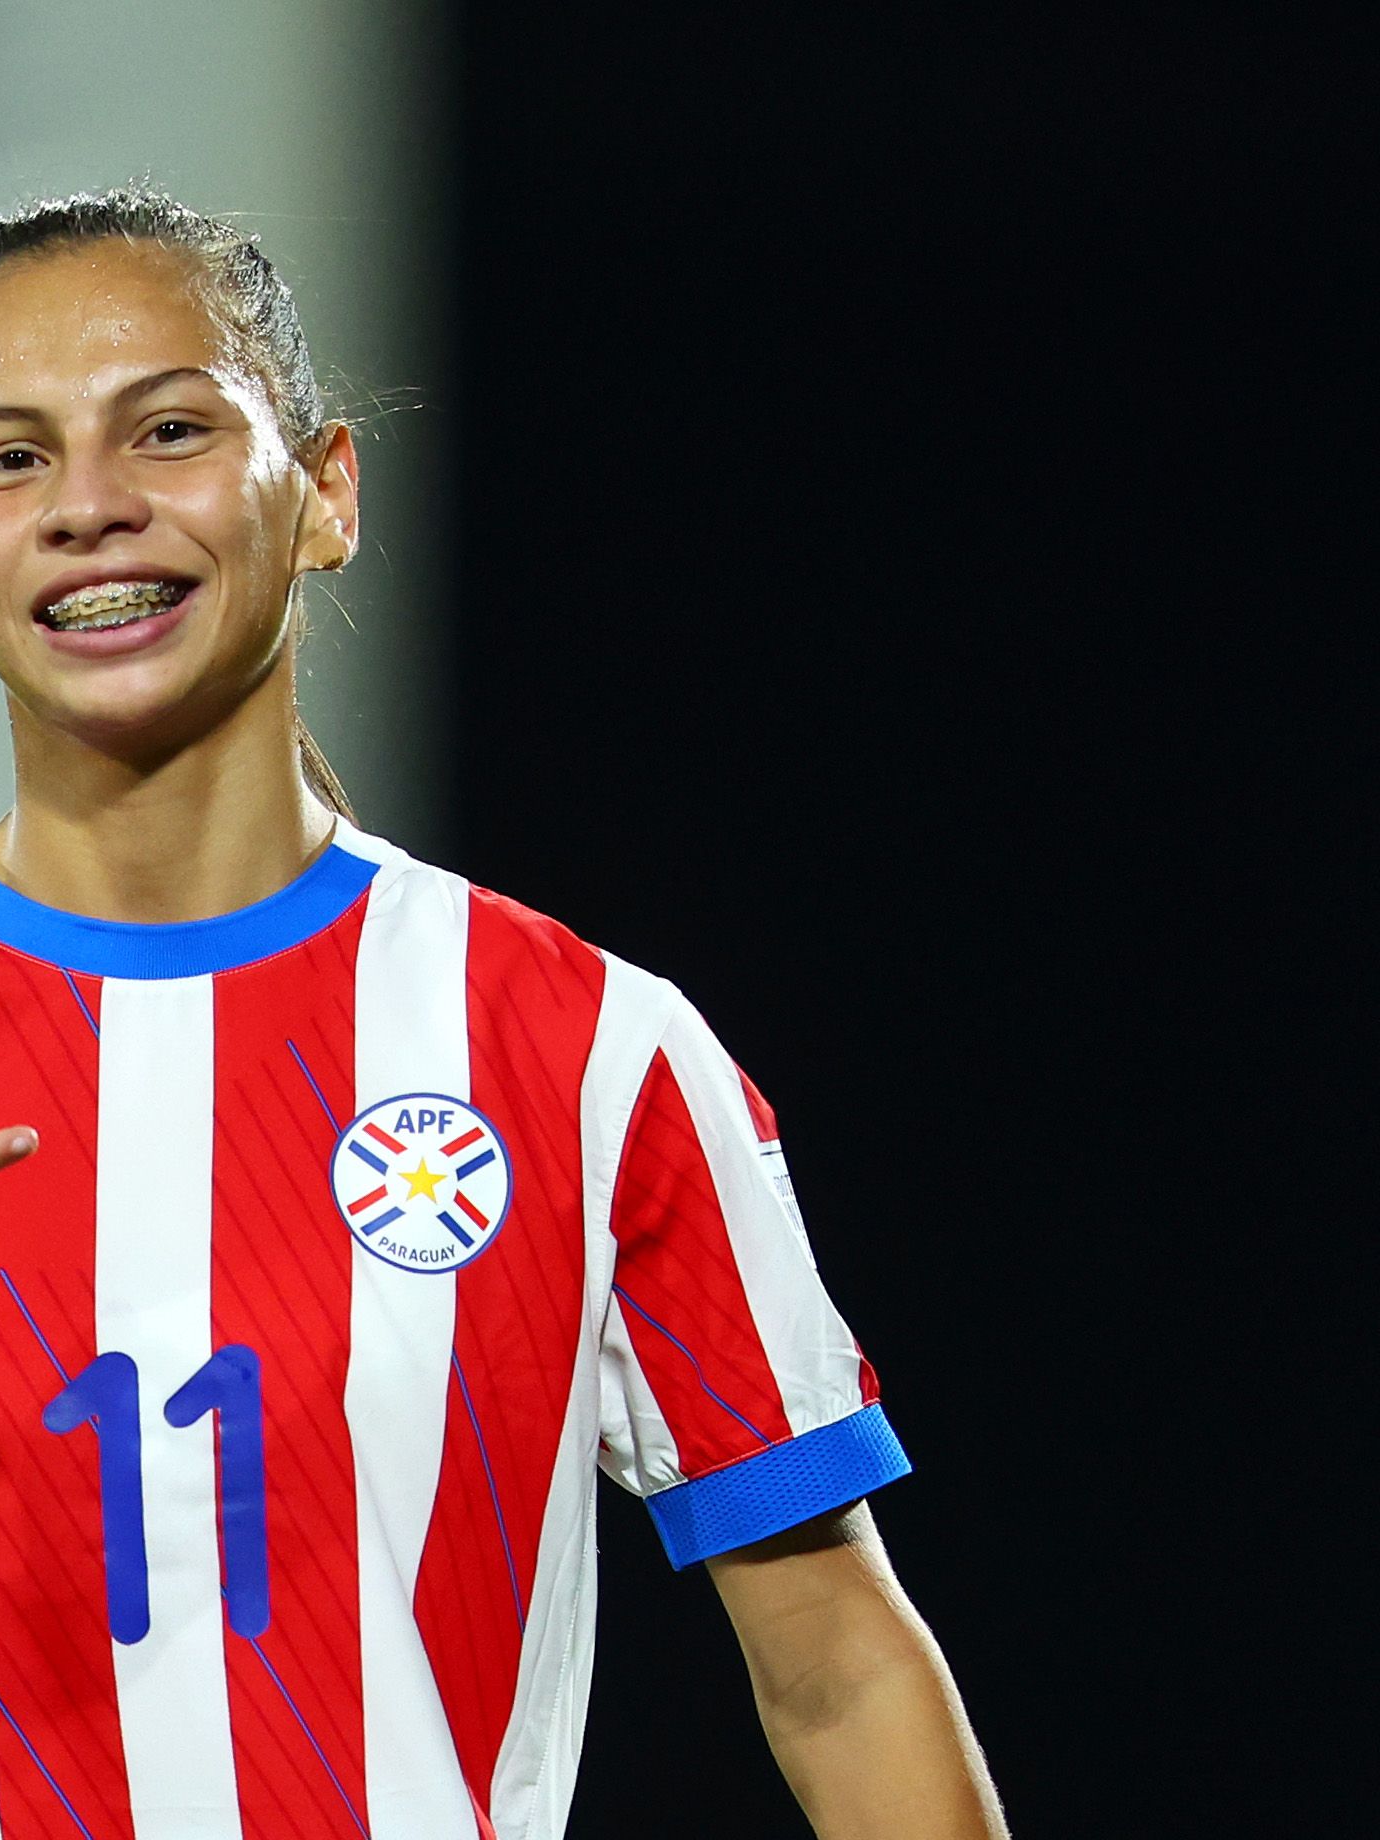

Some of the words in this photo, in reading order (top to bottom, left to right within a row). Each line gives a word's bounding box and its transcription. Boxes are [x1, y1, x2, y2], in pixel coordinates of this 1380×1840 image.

[393, 1109, 454, 1134] APF
[378, 1236, 456, 1263] PARAGUAY
[42, 1344, 270, 1645] 11
